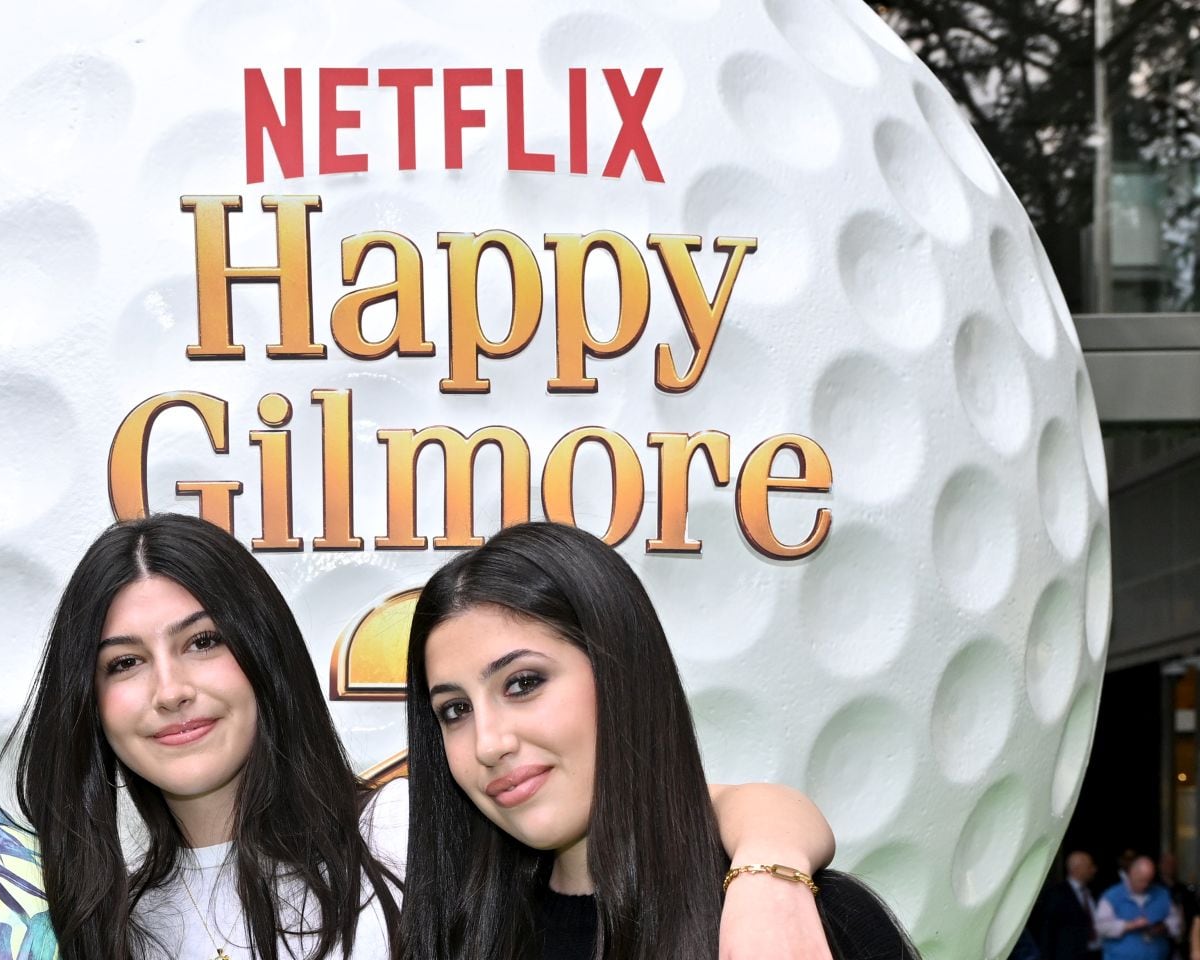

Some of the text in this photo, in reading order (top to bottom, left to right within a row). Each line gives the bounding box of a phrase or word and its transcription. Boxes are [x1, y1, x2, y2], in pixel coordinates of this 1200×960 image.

[244, 67, 666, 184] NETFLIX
[180, 194, 758, 395] Happy
[107, 389, 835, 560] Gilmore
